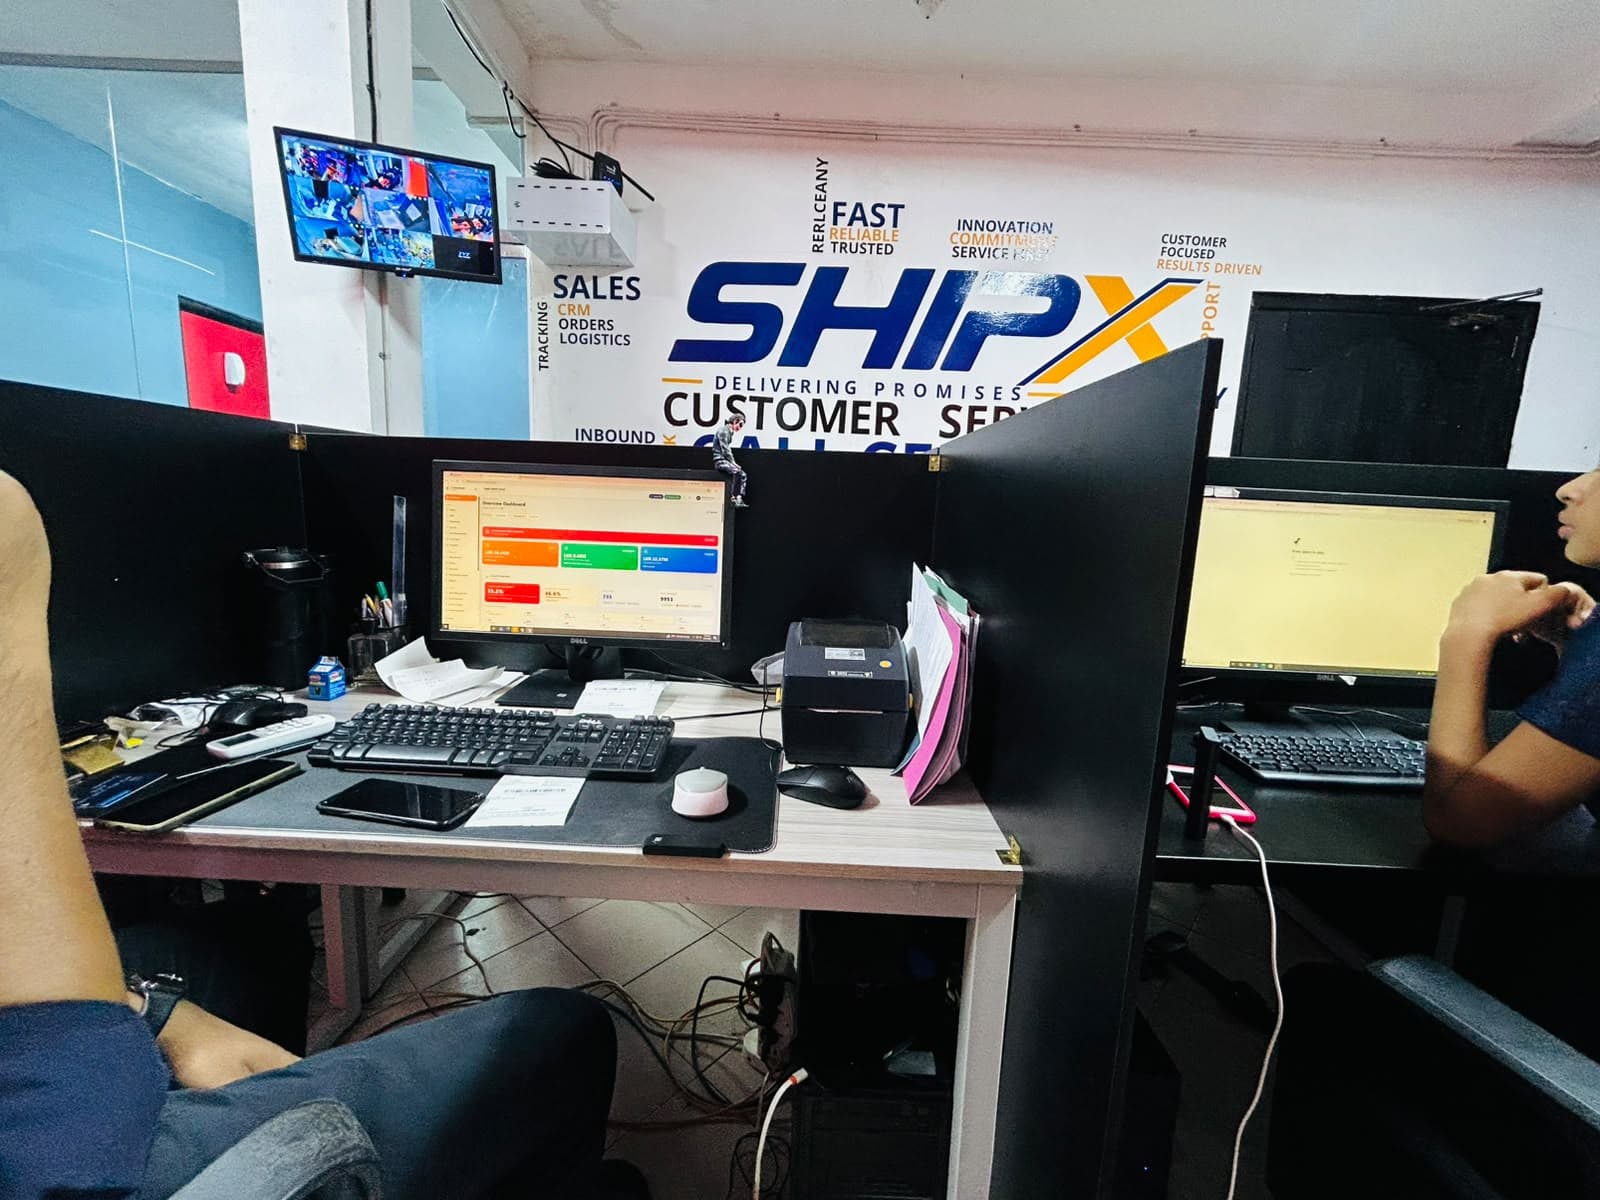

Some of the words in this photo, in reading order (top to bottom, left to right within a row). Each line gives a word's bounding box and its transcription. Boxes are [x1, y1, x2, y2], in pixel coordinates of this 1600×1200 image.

[811, 157, 829, 254] RERLCEANY
[832, 201, 905, 228] FAST
[829, 226, 900, 243] RELIABLE
[957, 218, 1054, 235] INNOVATION
[831, 240, 895, 256] TRUSTED
[950, 232, 1058, 250] COMMITM
[1161, 233, 1228, 249] CUSTOMER
[951, 245, 1009, 260] SERVICE
[1160, 247, 1216, 260] FOCUSED
[1156, 257, 1211, 274] RESULTS
[1214, 263, 1263, 276] DRIVEN
[553, 273, 642, 301] SALES
[557, 302, 592, 317] CRM
[558, 317, 615, 332] ORDERS
[537, 300, 549, 372] TRACKING
[559, 331, 632, 347] LOGISTICS
[715, 375, 858, 395] DELIVERING
[874, 381, 1022, 401] PROMISES
[663, 391, 902, 437] CUSTOMER
[574, 427, 657, 444] INBOUND
